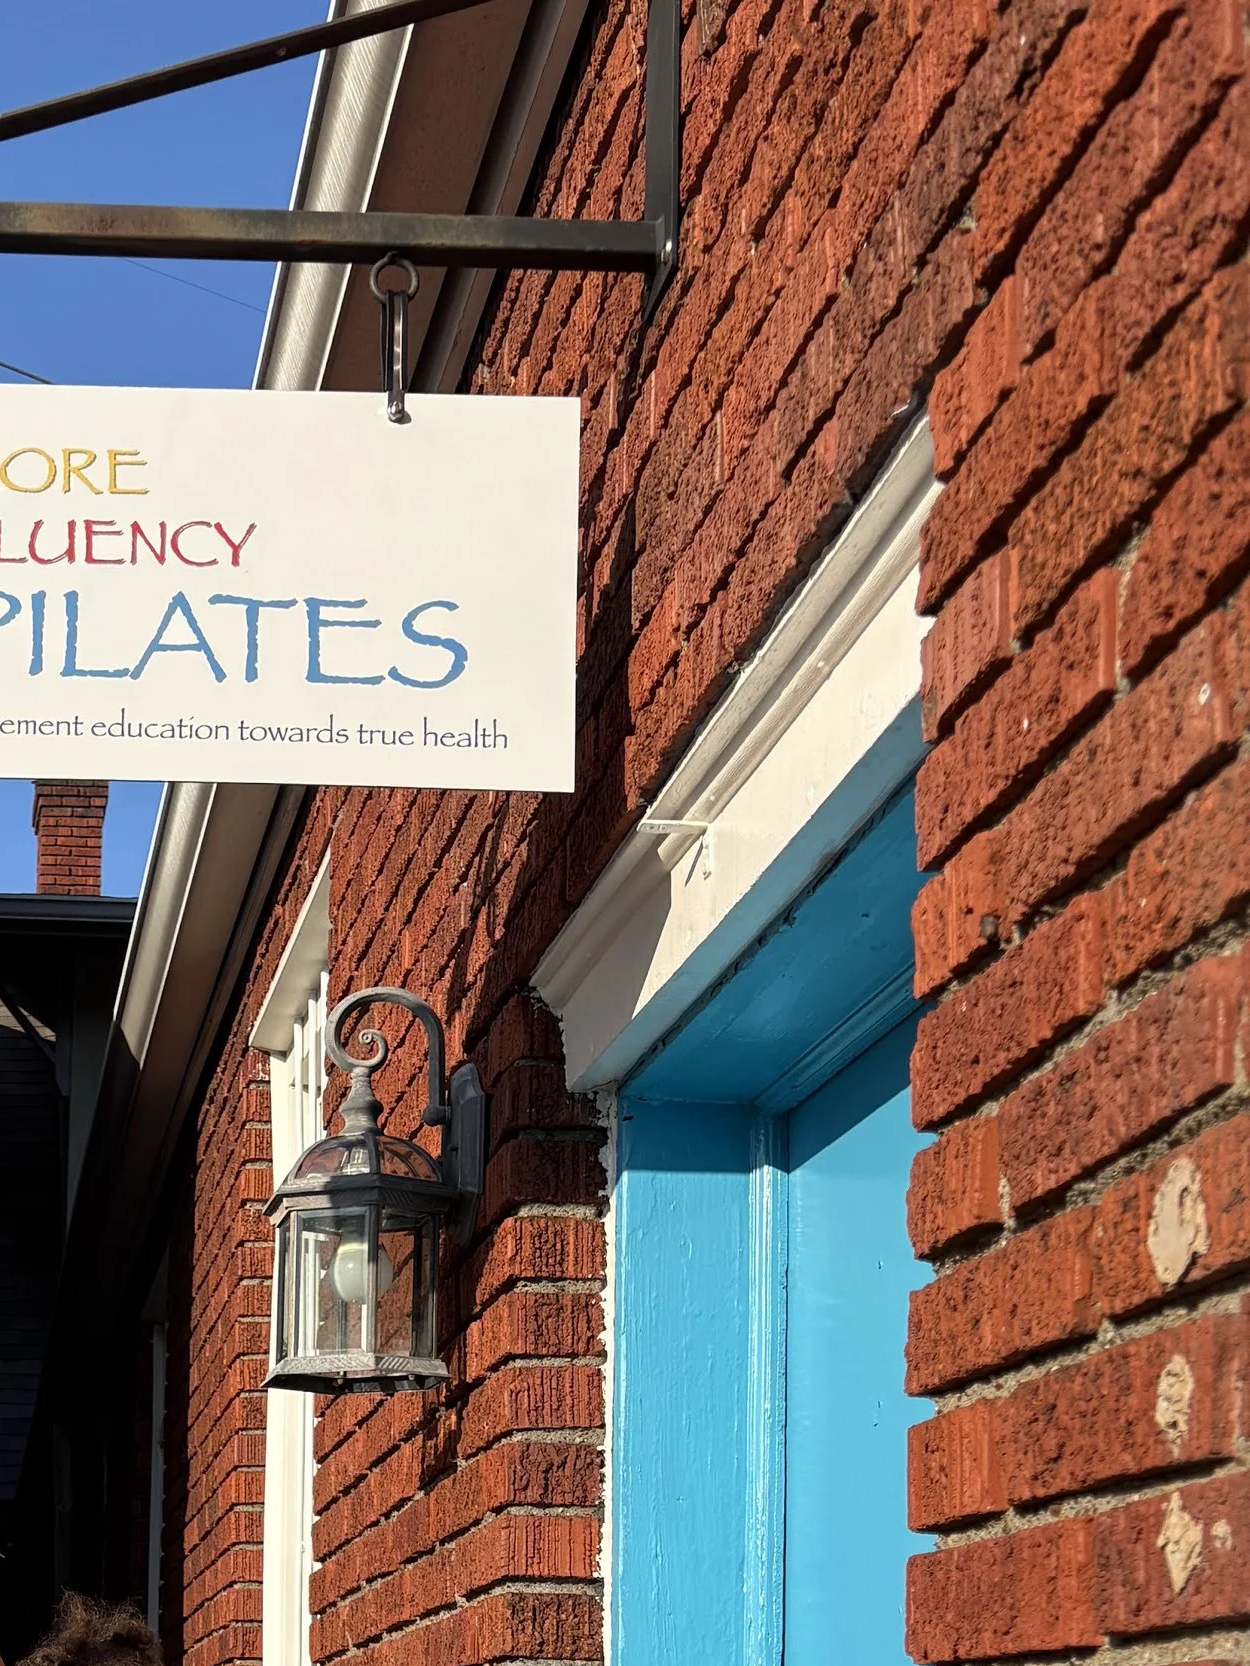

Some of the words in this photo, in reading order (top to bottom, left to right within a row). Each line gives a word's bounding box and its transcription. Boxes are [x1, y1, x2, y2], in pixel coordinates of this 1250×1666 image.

[91, 708, 229, 740] education
[238, 714, 349, 743] towards
[357, 724, 414, 745] true
[424, 717, 507, 748] health
